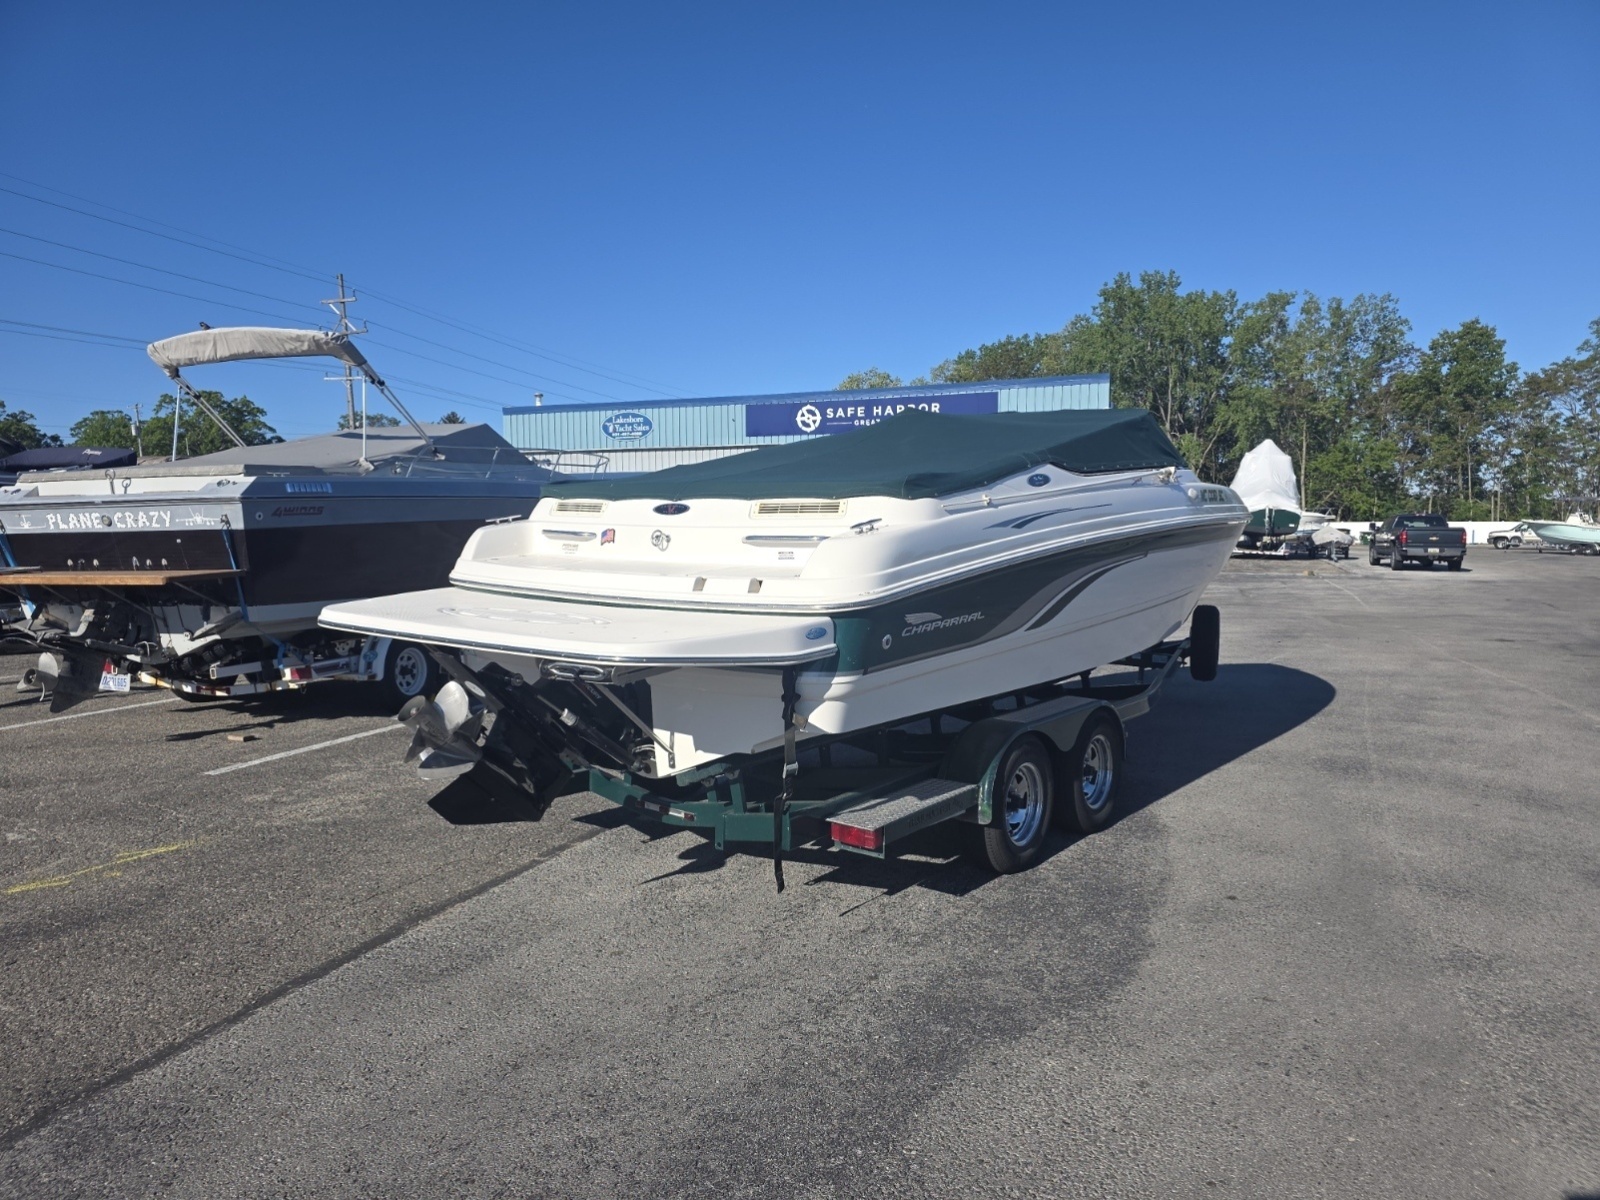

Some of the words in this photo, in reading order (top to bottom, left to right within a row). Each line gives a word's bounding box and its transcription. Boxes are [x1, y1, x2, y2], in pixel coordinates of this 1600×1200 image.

[826, 406, 866, 418] SAFE
[873, 402, 940, 417] HAROR
[612, 415, 644, 424] Lakeshore
[615, 424, 632, 432] Yacht
[633, 423, 650, 431] Sales
[46, 512, 103, 530] PLANE
[113, 510, 171, 528] CRAZY
[901, 611, 985, 637] CHAPARRAL
